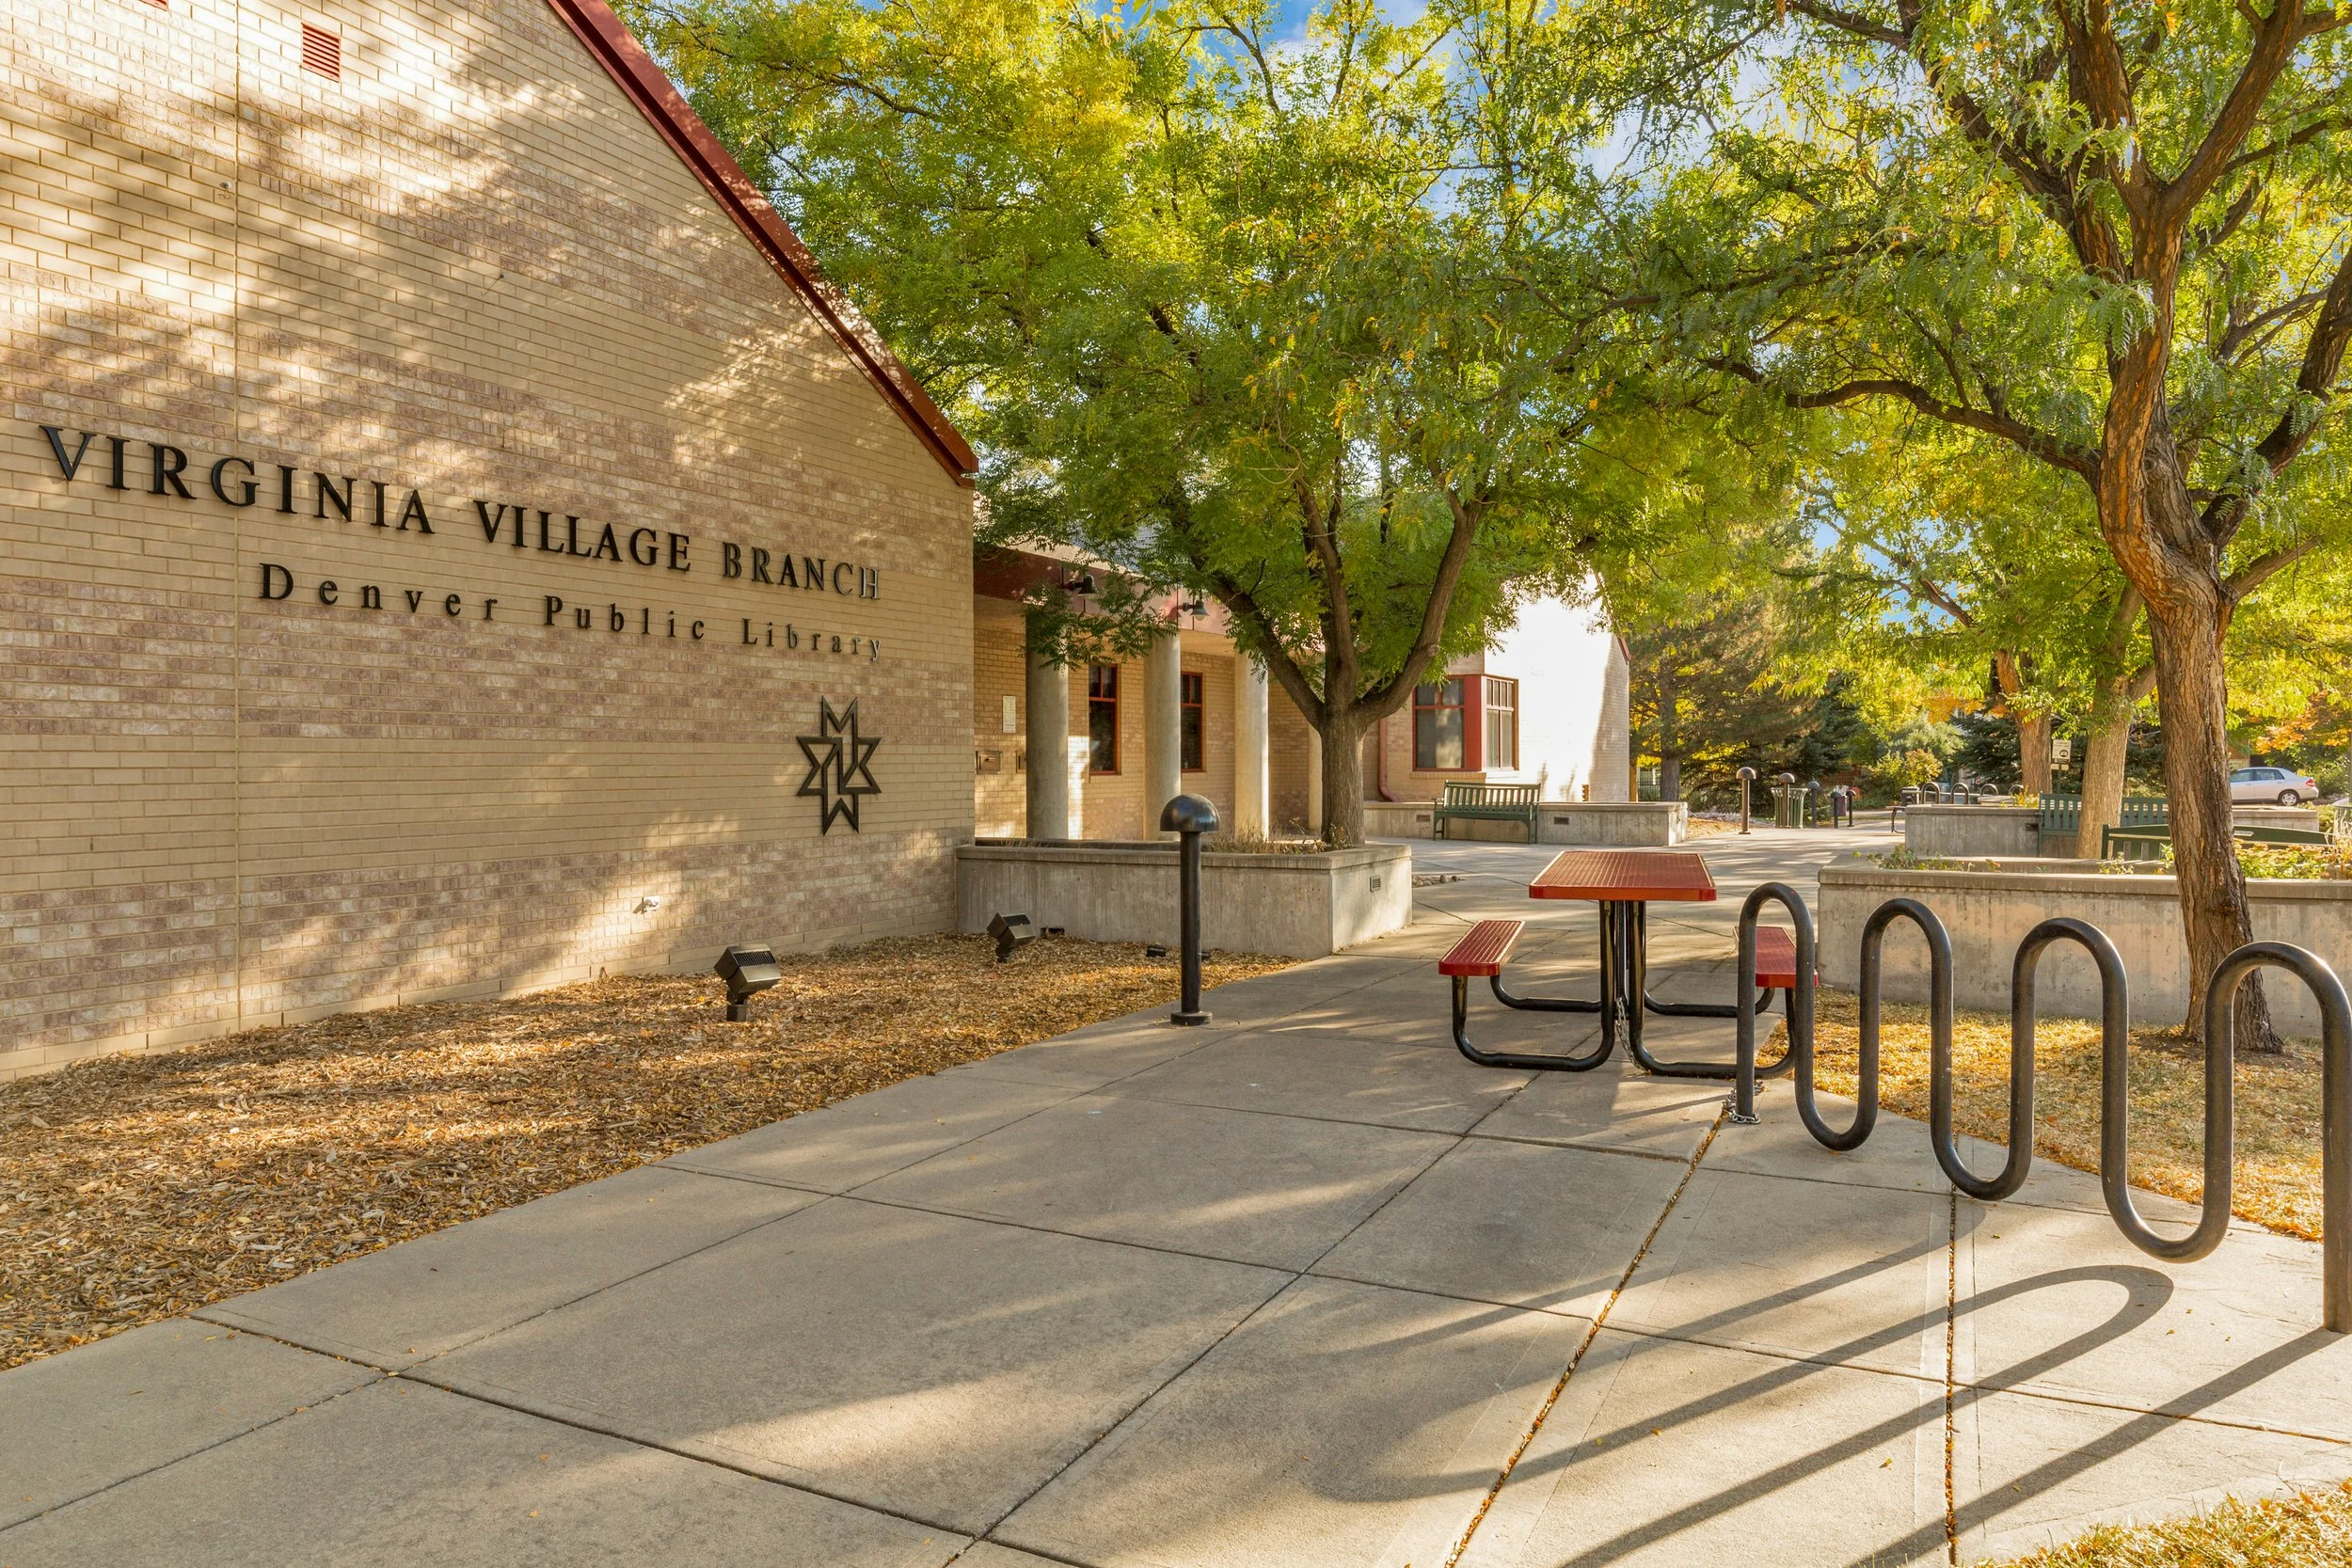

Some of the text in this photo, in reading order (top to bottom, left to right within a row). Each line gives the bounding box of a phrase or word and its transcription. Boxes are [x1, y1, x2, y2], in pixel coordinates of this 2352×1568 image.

[40, 425, 881, 600] VIRGINIA VILLAGE BRANCH
[259, 562, 882, 662] Denver Public Library
